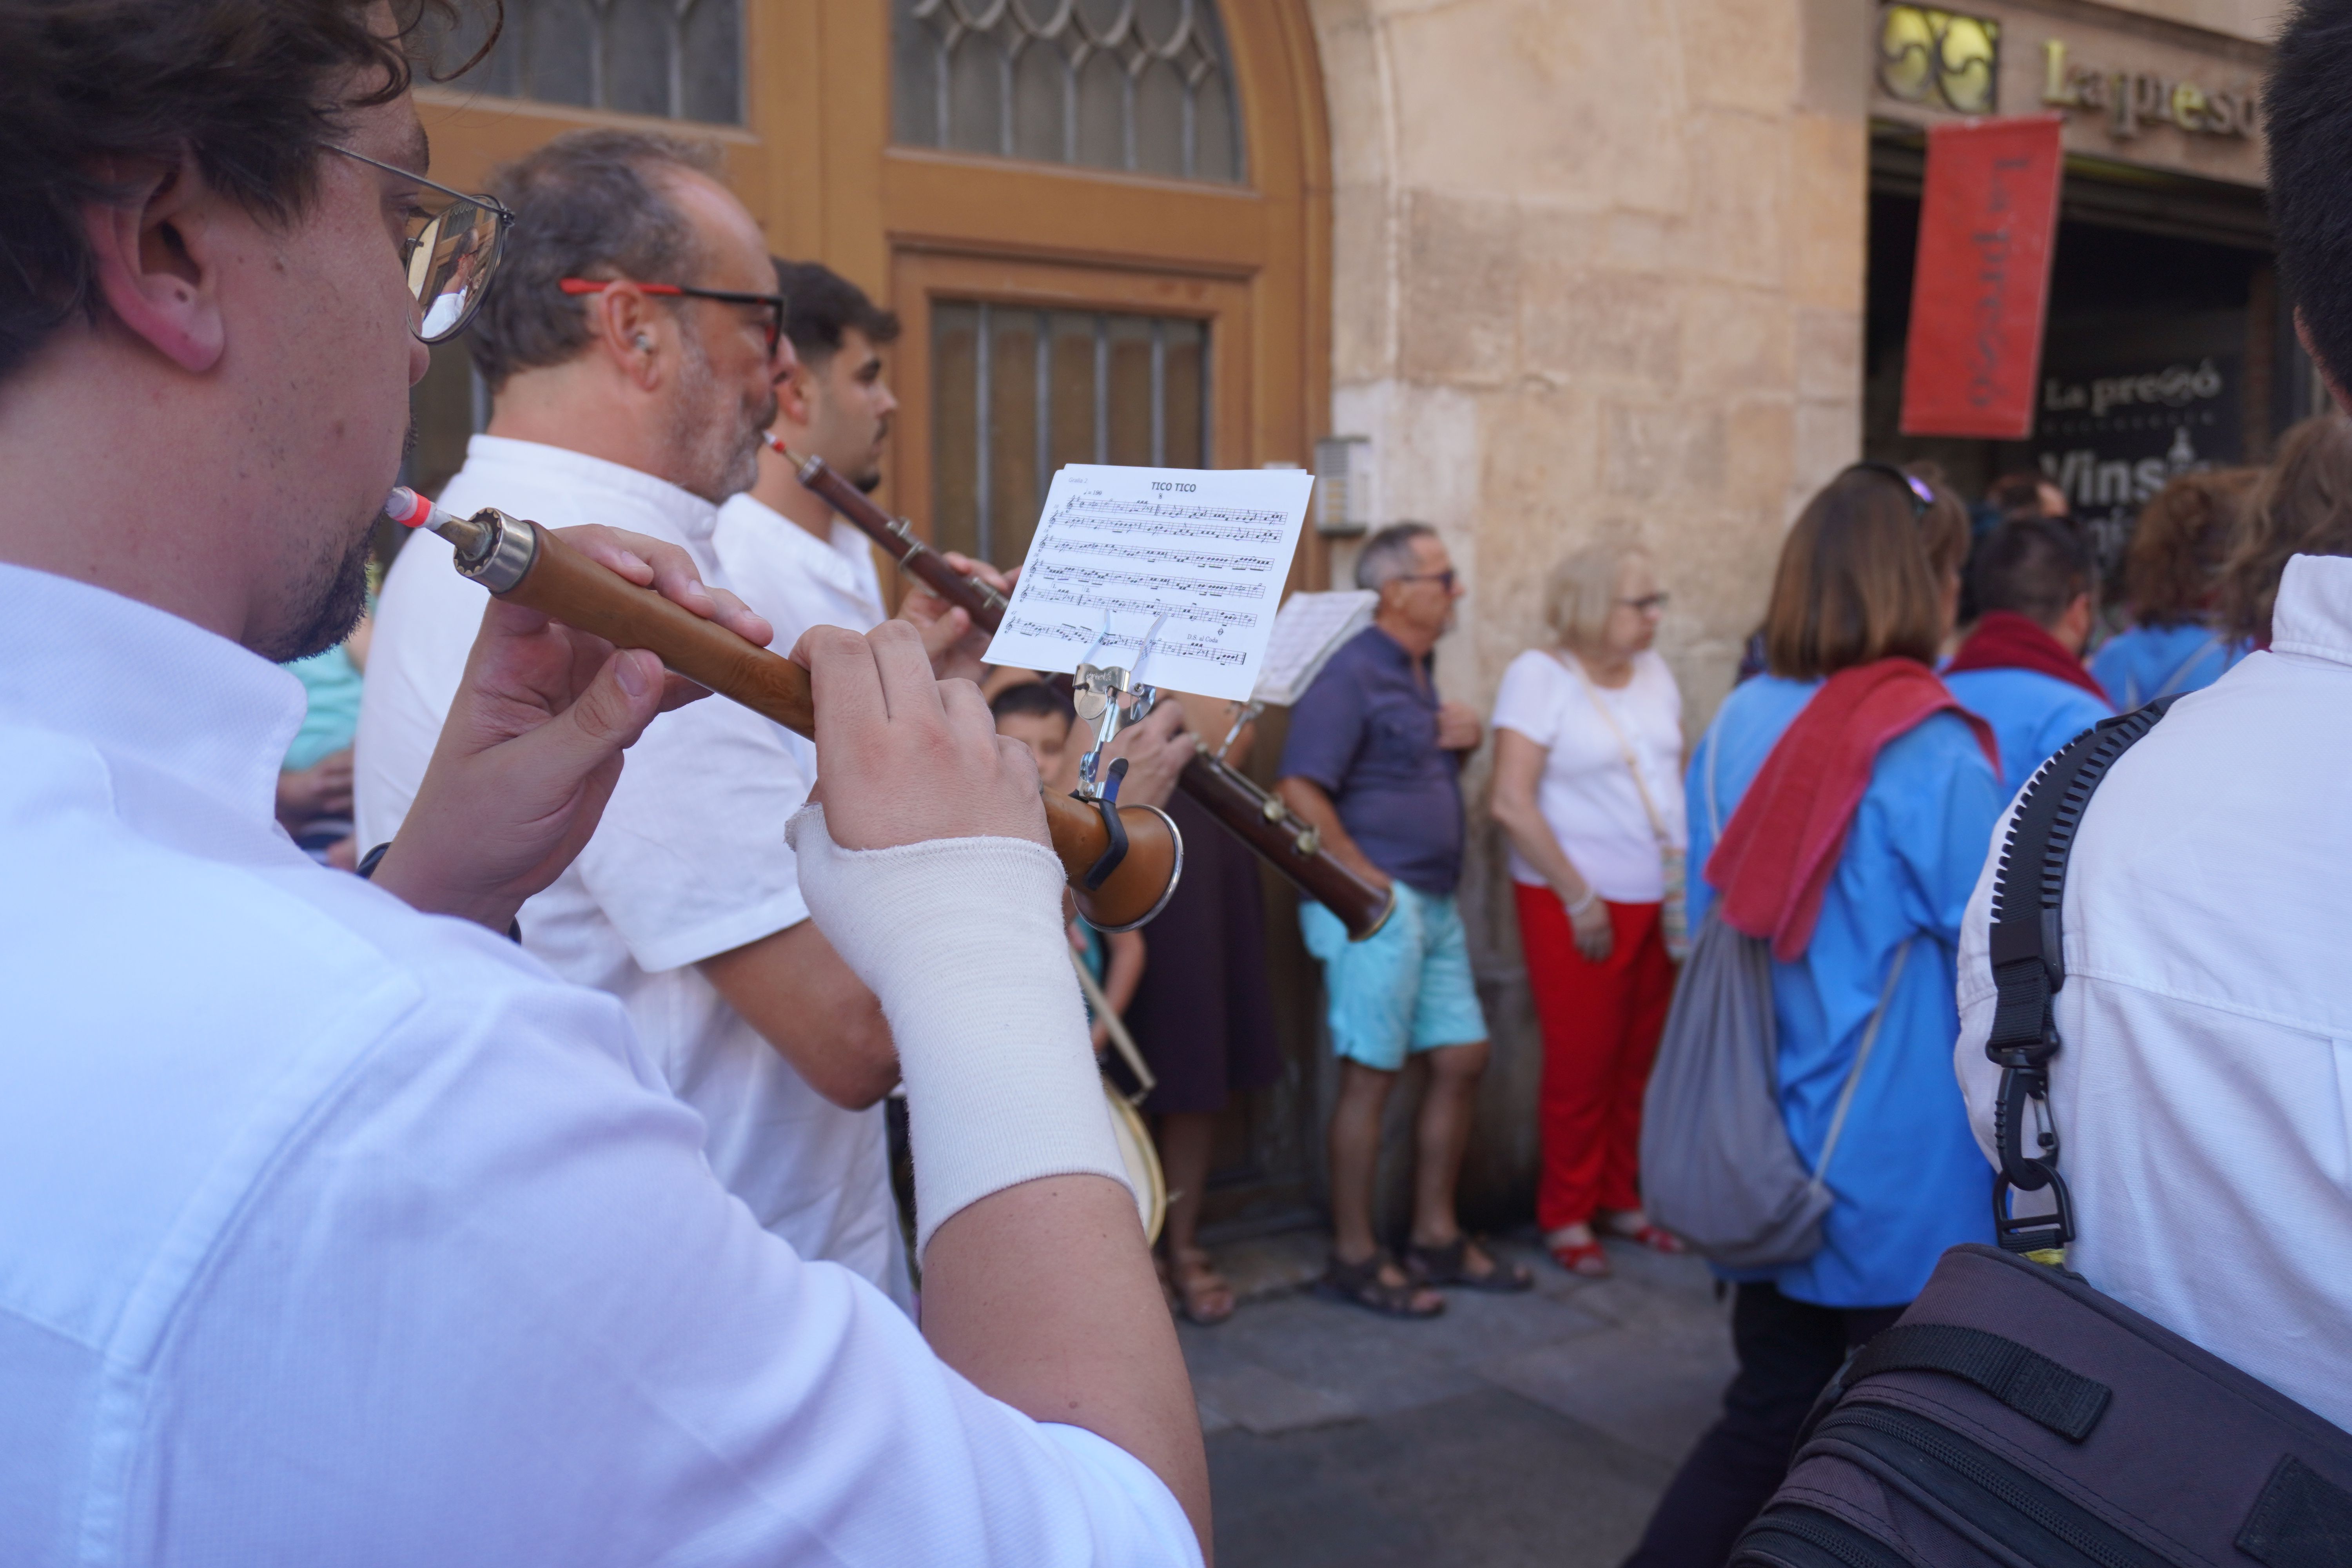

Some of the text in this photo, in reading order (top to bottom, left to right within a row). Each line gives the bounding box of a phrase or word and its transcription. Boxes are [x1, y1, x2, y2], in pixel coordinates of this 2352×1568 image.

[2040, 39, 2107, 108] La
[1151, 481, 1196, 492] TICO TICO
